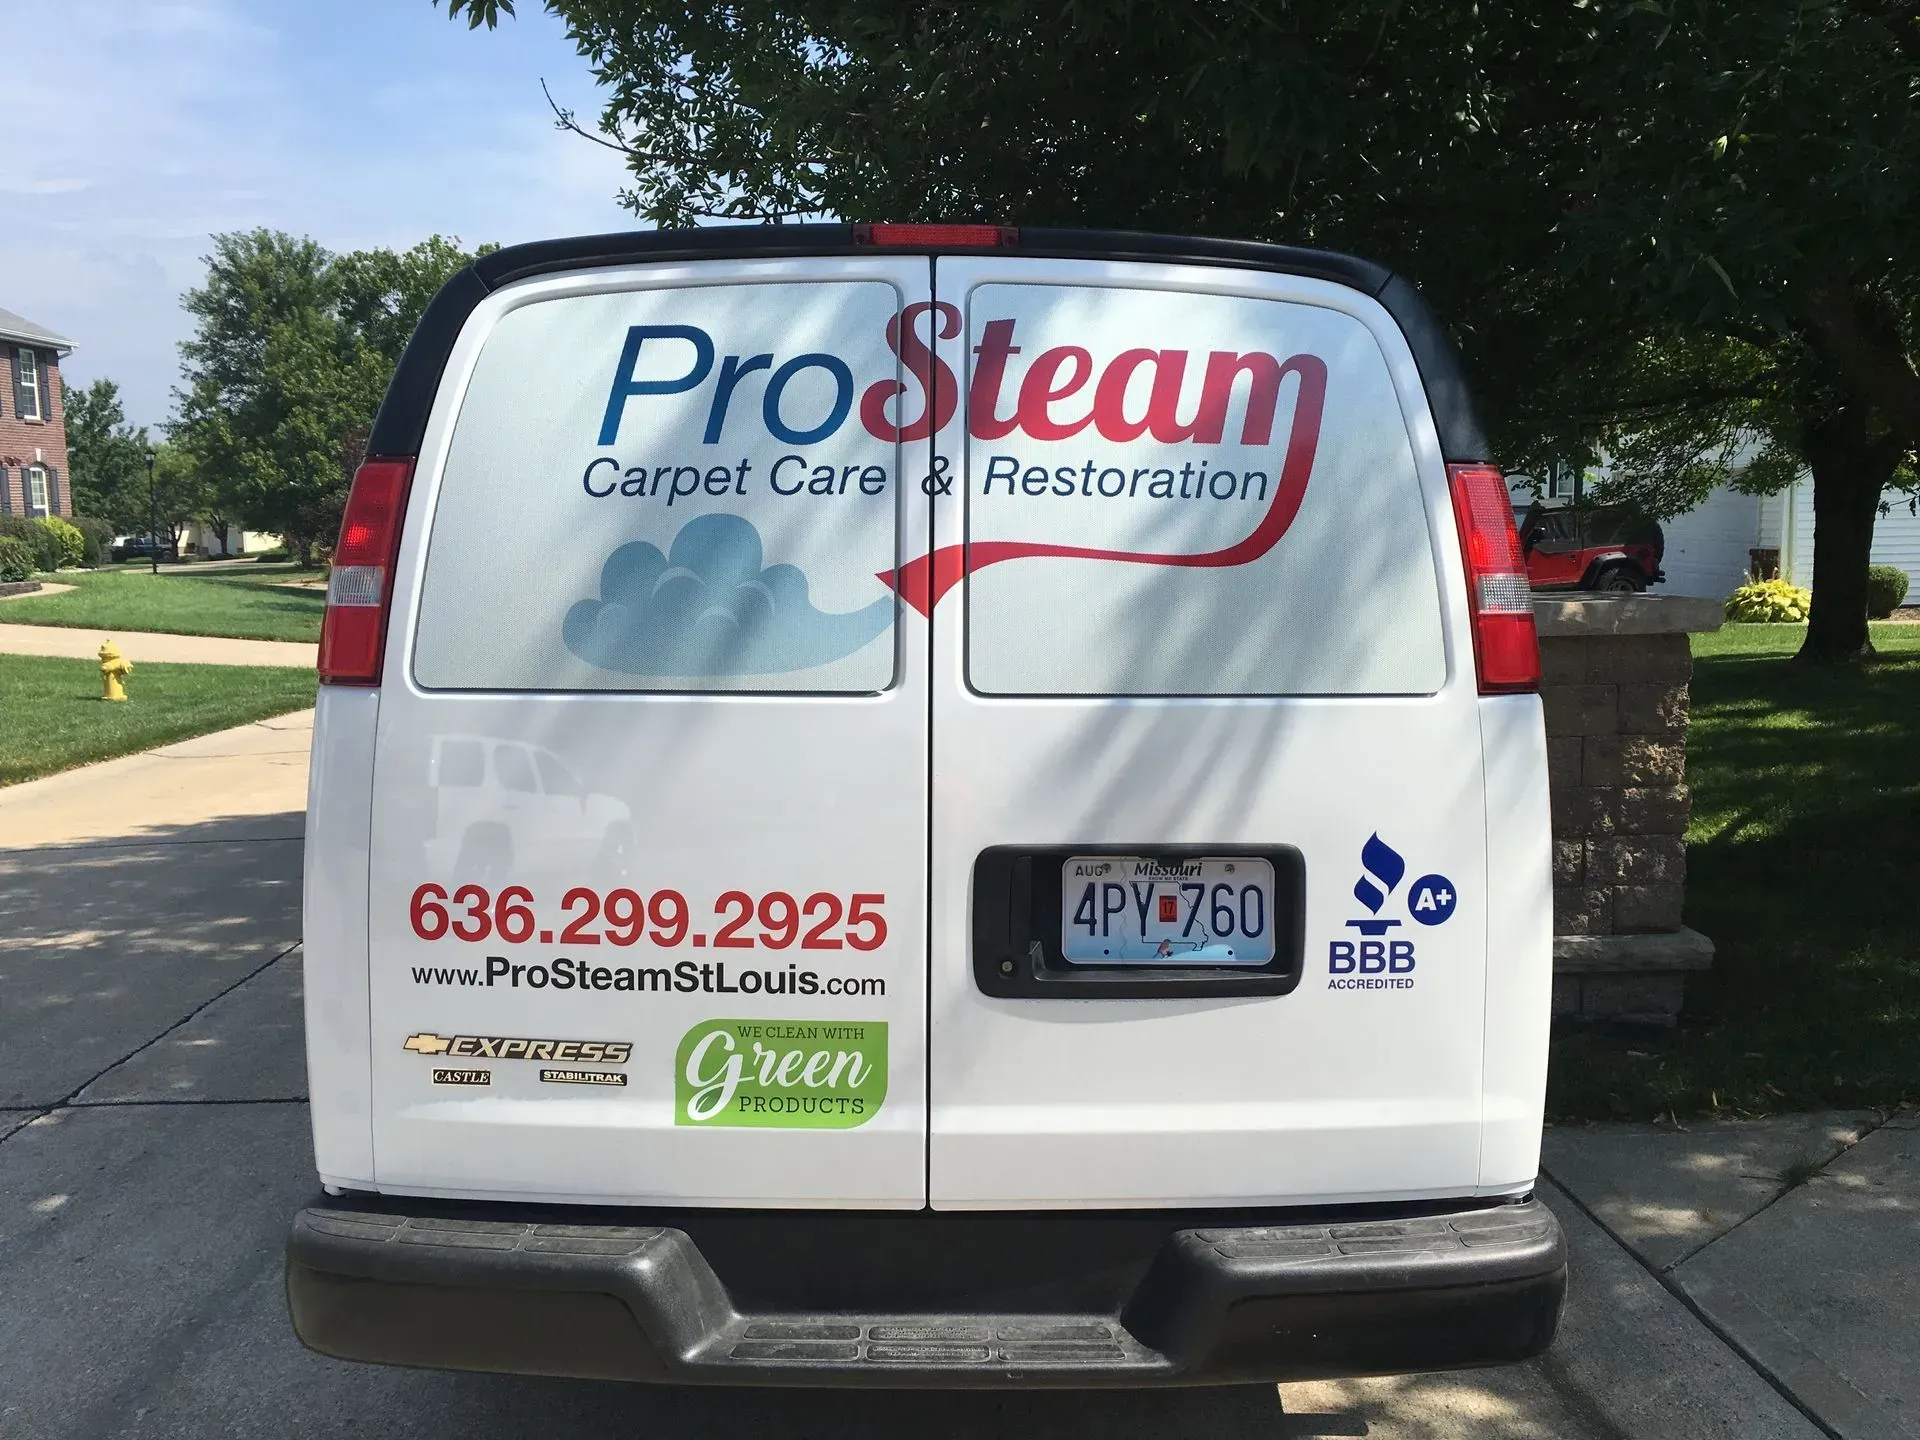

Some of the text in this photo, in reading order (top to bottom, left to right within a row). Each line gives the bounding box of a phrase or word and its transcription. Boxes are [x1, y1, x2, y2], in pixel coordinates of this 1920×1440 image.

[596, 300, 1328, 447] ProSteam
[582, 455, 1268, 507] Carpet Care & Restoration
[1075, 866, 1103, 877] AUG
[1134, 862, 1203, 877] Missouri
[1073, 882, 1264, 939] 4PY 760
[1415, 887, 1452, 911] A+
[409, 882, 888, 951] 636.299.2925
[1328, 940, 1416, 974] BBB
[411, 955, 887, 996] www.ProSteamStLouis.com
[1328, 978, 1414, 990] ACCREDITED
[737, 1025, 865, 1040] WE CLEAN WITH
[449, 1036, 633, 1063] EXPRESS
[433, 1070, 490, 1083] CASTLE
[542, 1070, 624, 1083] STABILITRAK
[685, 1030, 873, 1121] Green
[739, 1095, 864, 1114] PRODUCTS
